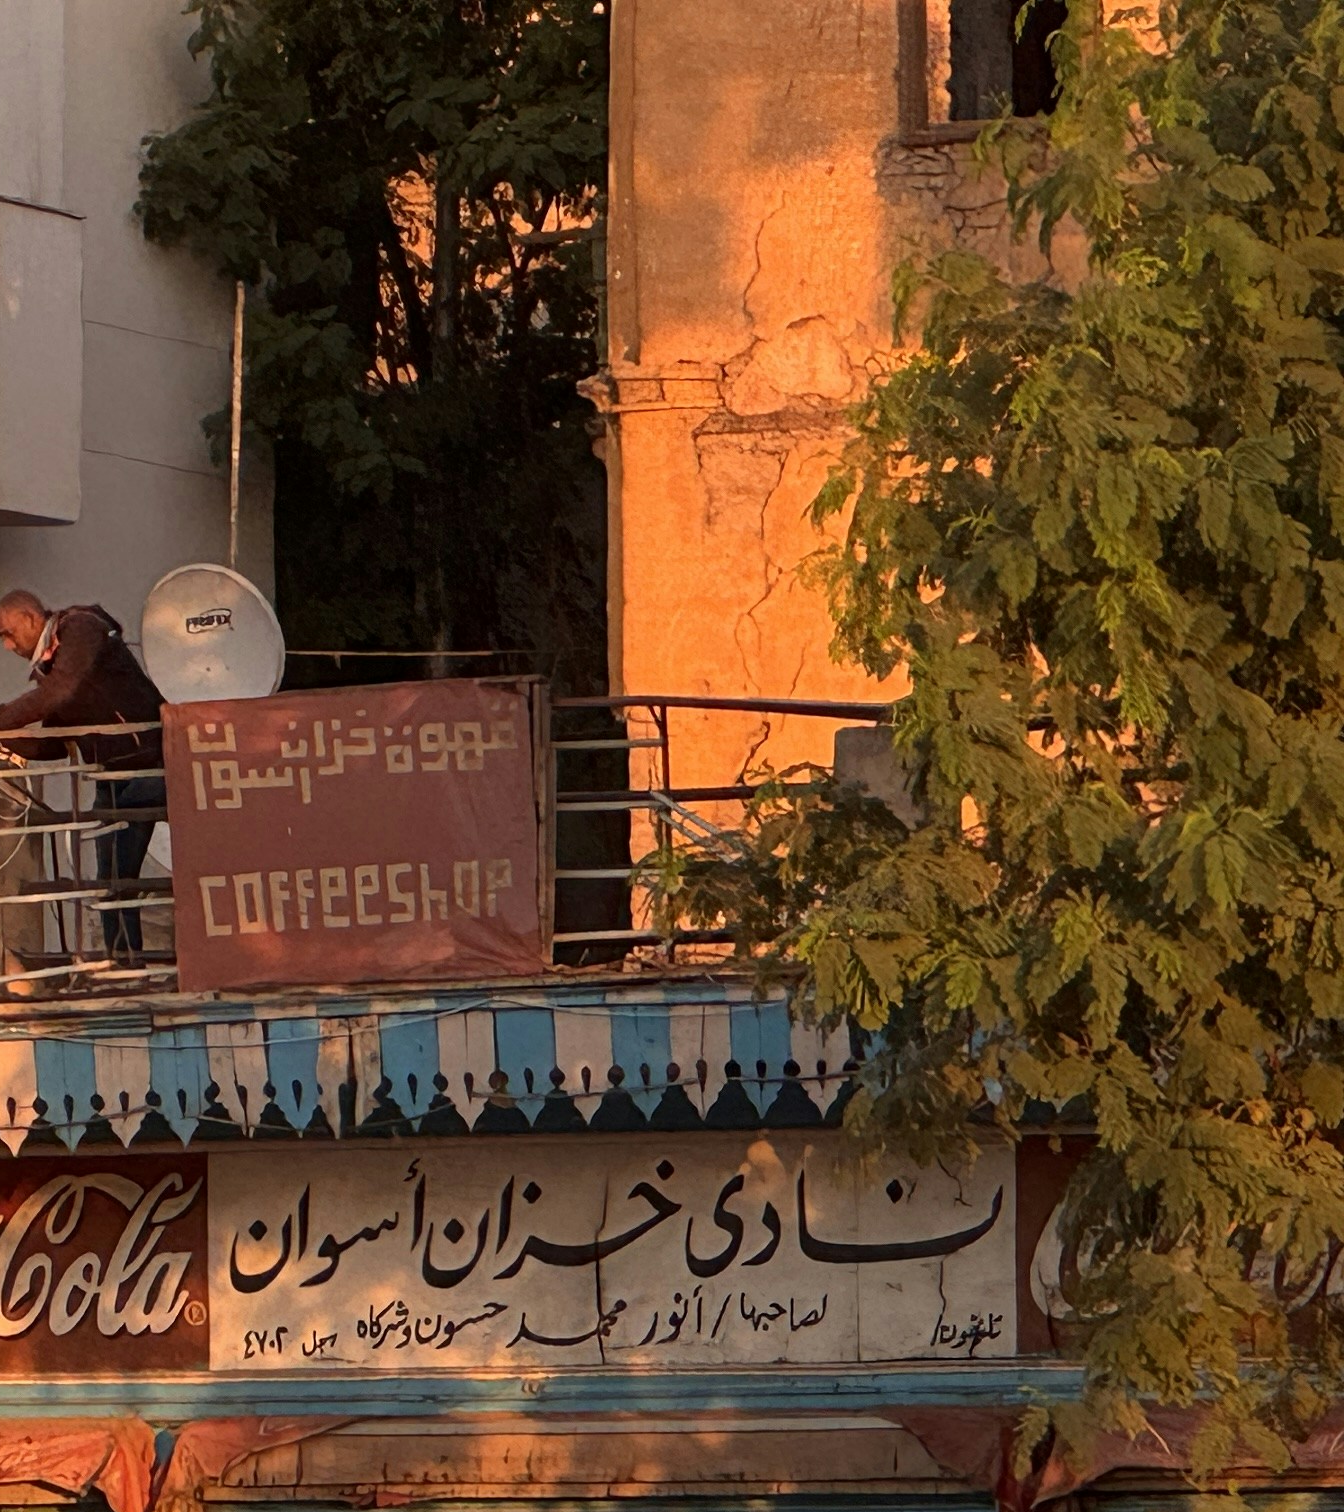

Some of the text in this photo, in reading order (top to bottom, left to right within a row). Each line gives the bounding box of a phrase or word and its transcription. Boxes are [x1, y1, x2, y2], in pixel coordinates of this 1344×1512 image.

[229, 1157, 426, 1294] أسوان
[422, 1158, 684, 1290] خزان
[506, 1300, 628, 1350] محمد
